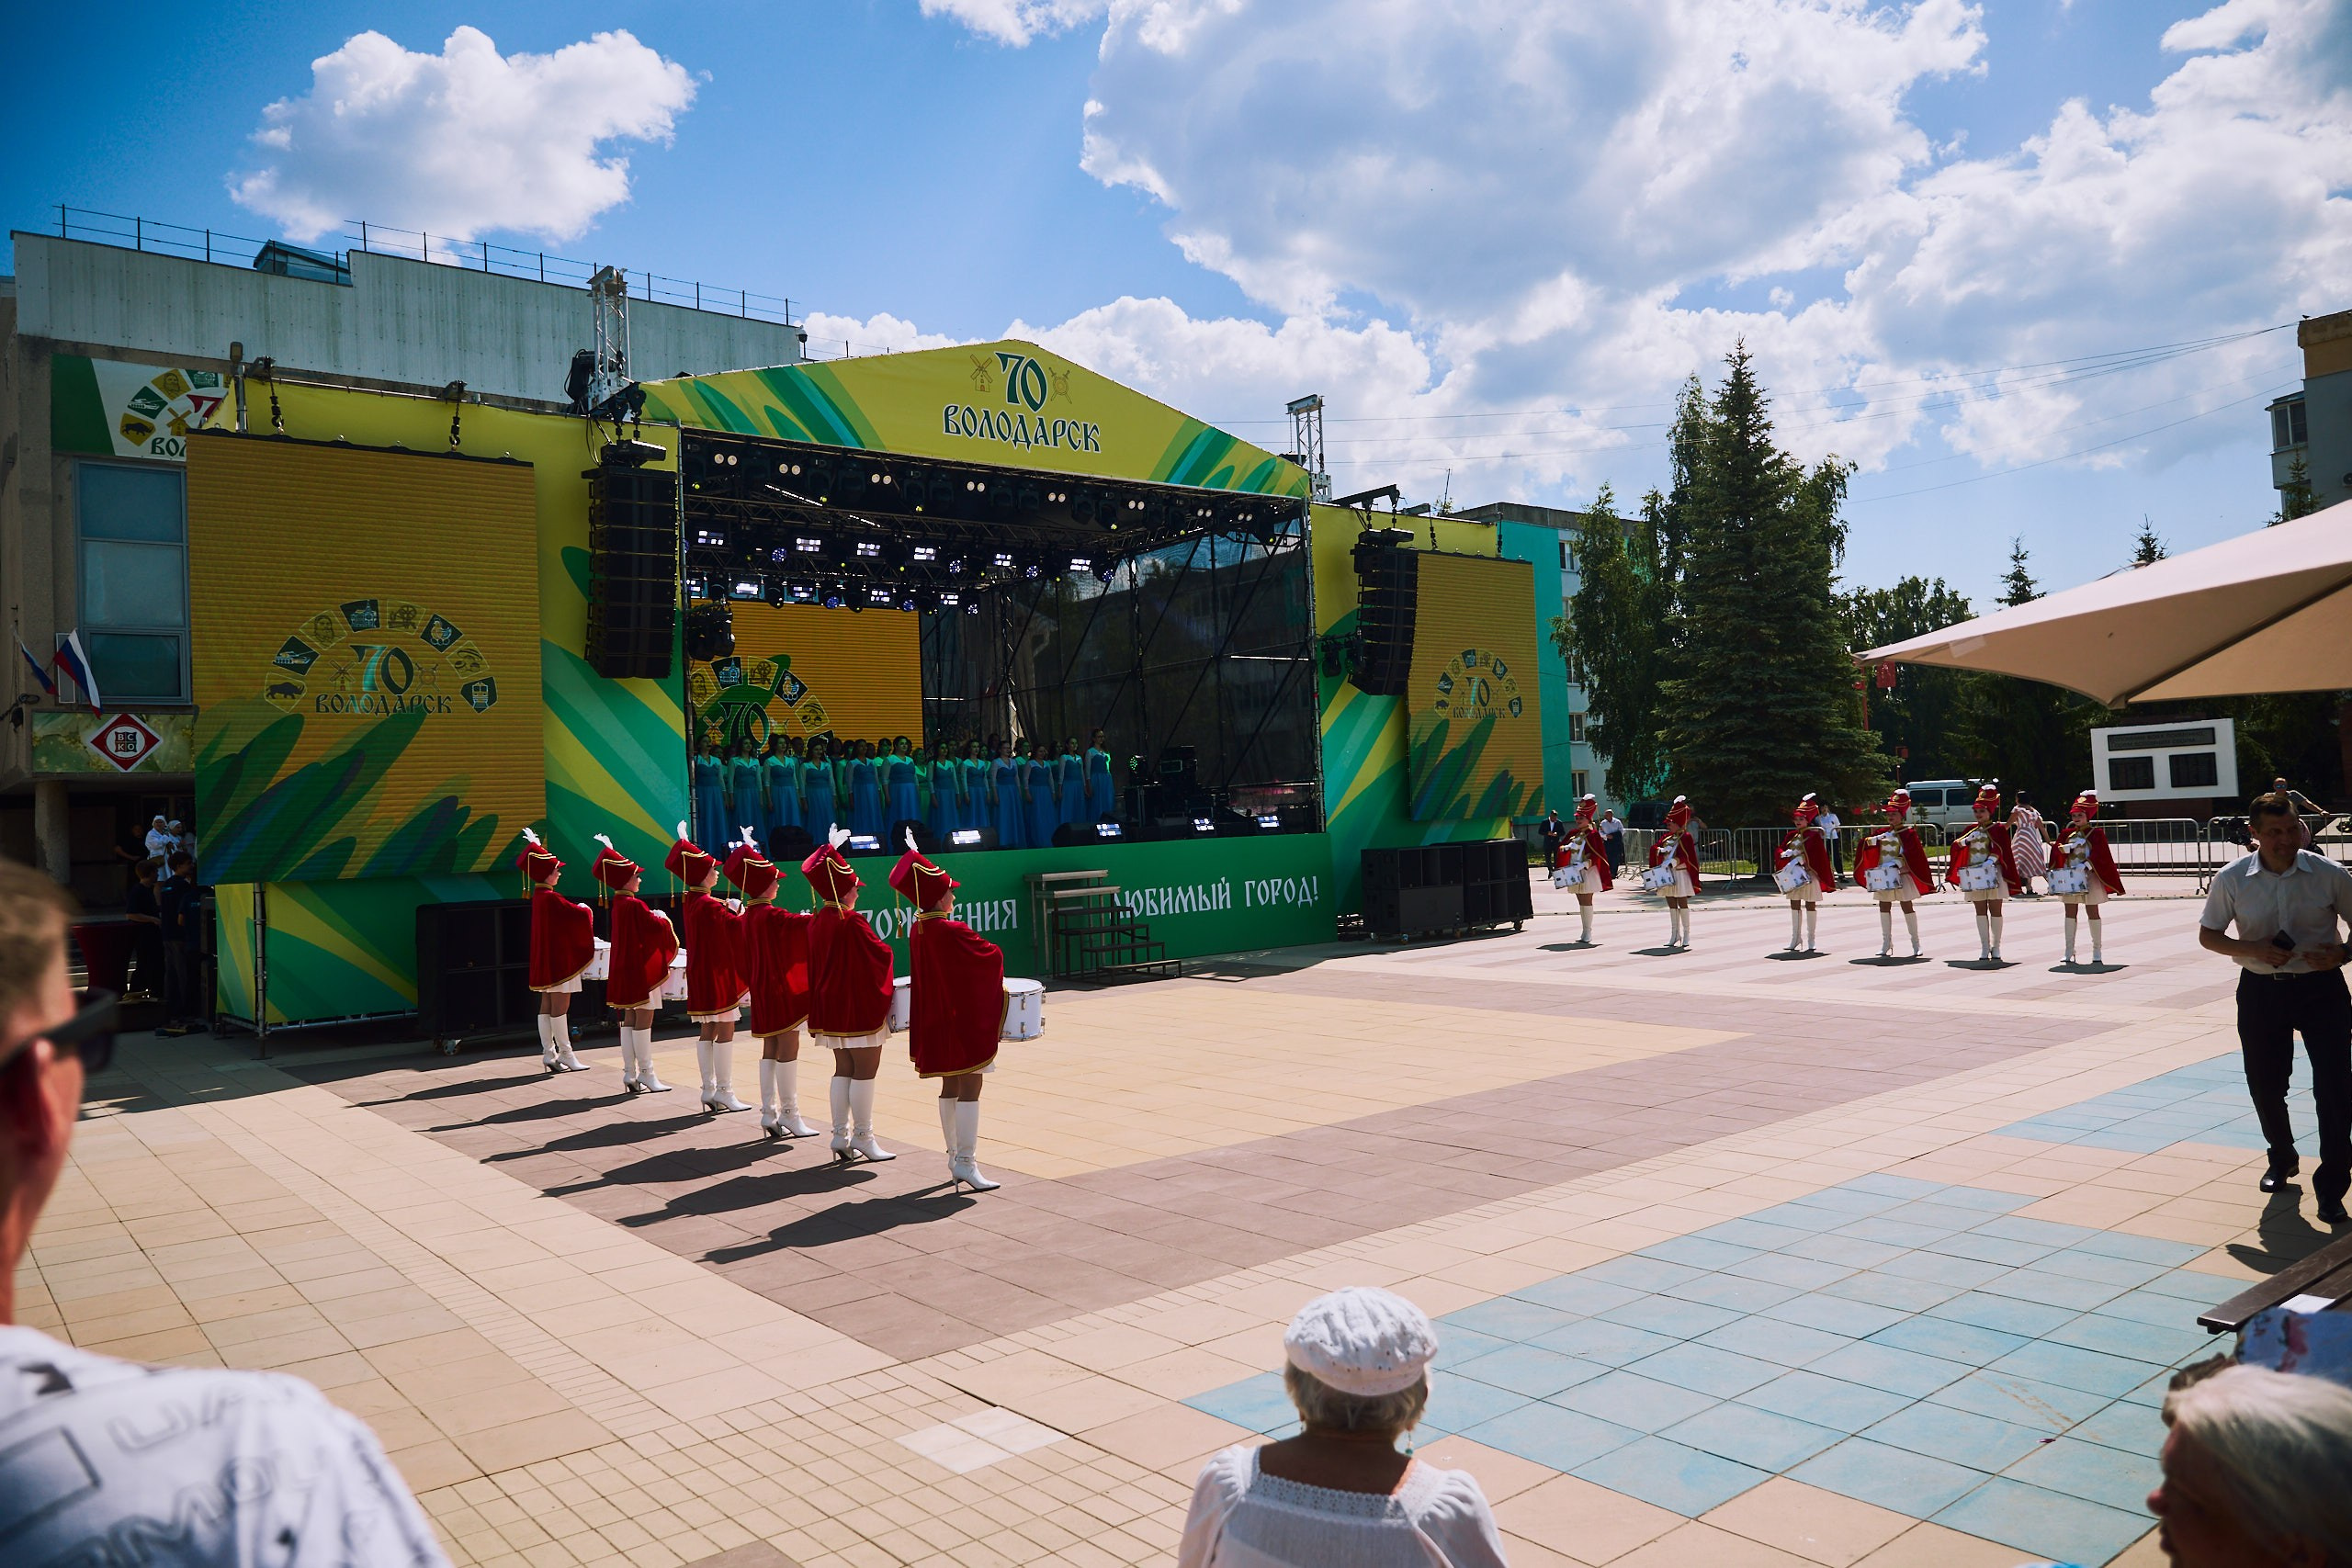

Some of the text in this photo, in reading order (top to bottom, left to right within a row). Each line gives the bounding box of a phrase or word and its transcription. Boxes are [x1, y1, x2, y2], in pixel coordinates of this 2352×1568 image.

[995, 352, 1047, 413] 70
[943, 404, 1102, 453] ВОЛОДАРСК
[349, 644, 414, 696] 70
[1465, 676, 1490, 707] 70
[315, 694, 453, 717] ВОЛОДАРСК
[718, 701, 770, 749] 70
[856, 898, 1018, 941] ОЖЕНИЯ
[1244, 875, 1319, 908] ГОРОД!
